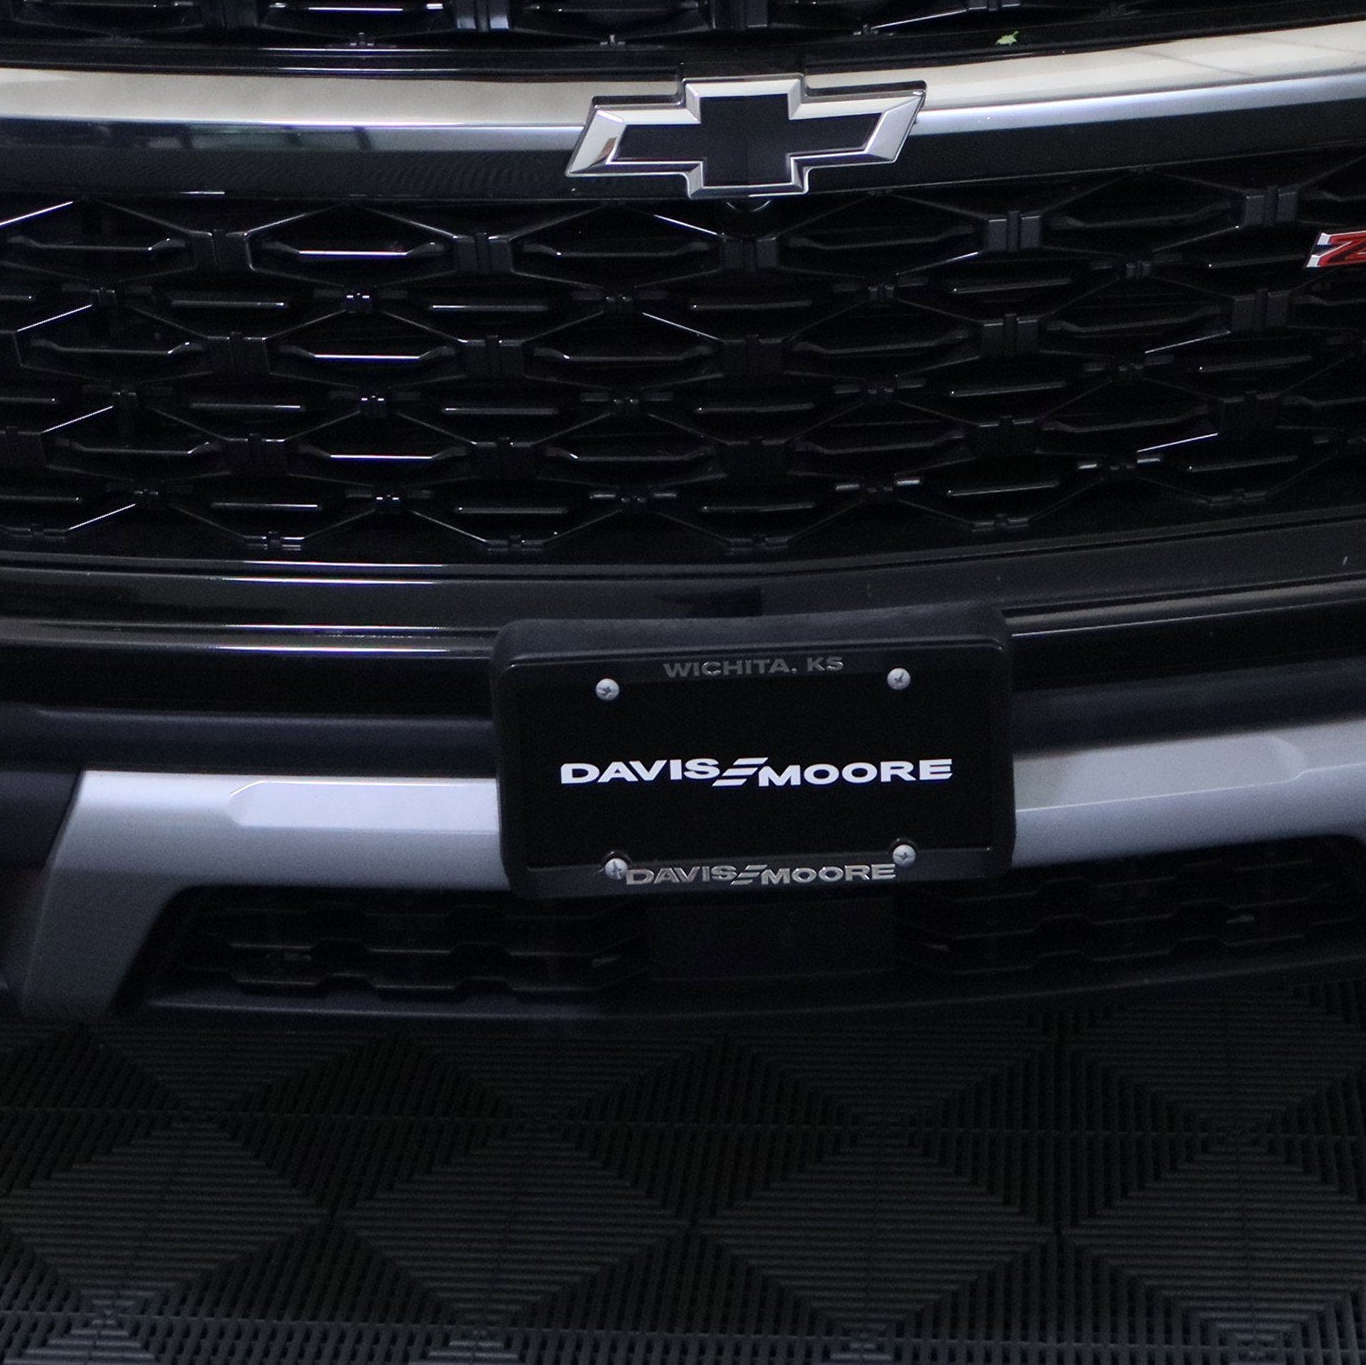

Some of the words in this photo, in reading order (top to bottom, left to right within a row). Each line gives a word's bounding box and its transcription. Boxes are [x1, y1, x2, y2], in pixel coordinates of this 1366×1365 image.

[663, 658, 798, 678] WICHITA,
[806, 655, 844, 673] KS
[560, 757, 721, 785] DAVIS
[757, 758, 953, 787] MOORE
[625, 864, 737, 886] DAVIS
[760, 863, 897, 886] MOORE
